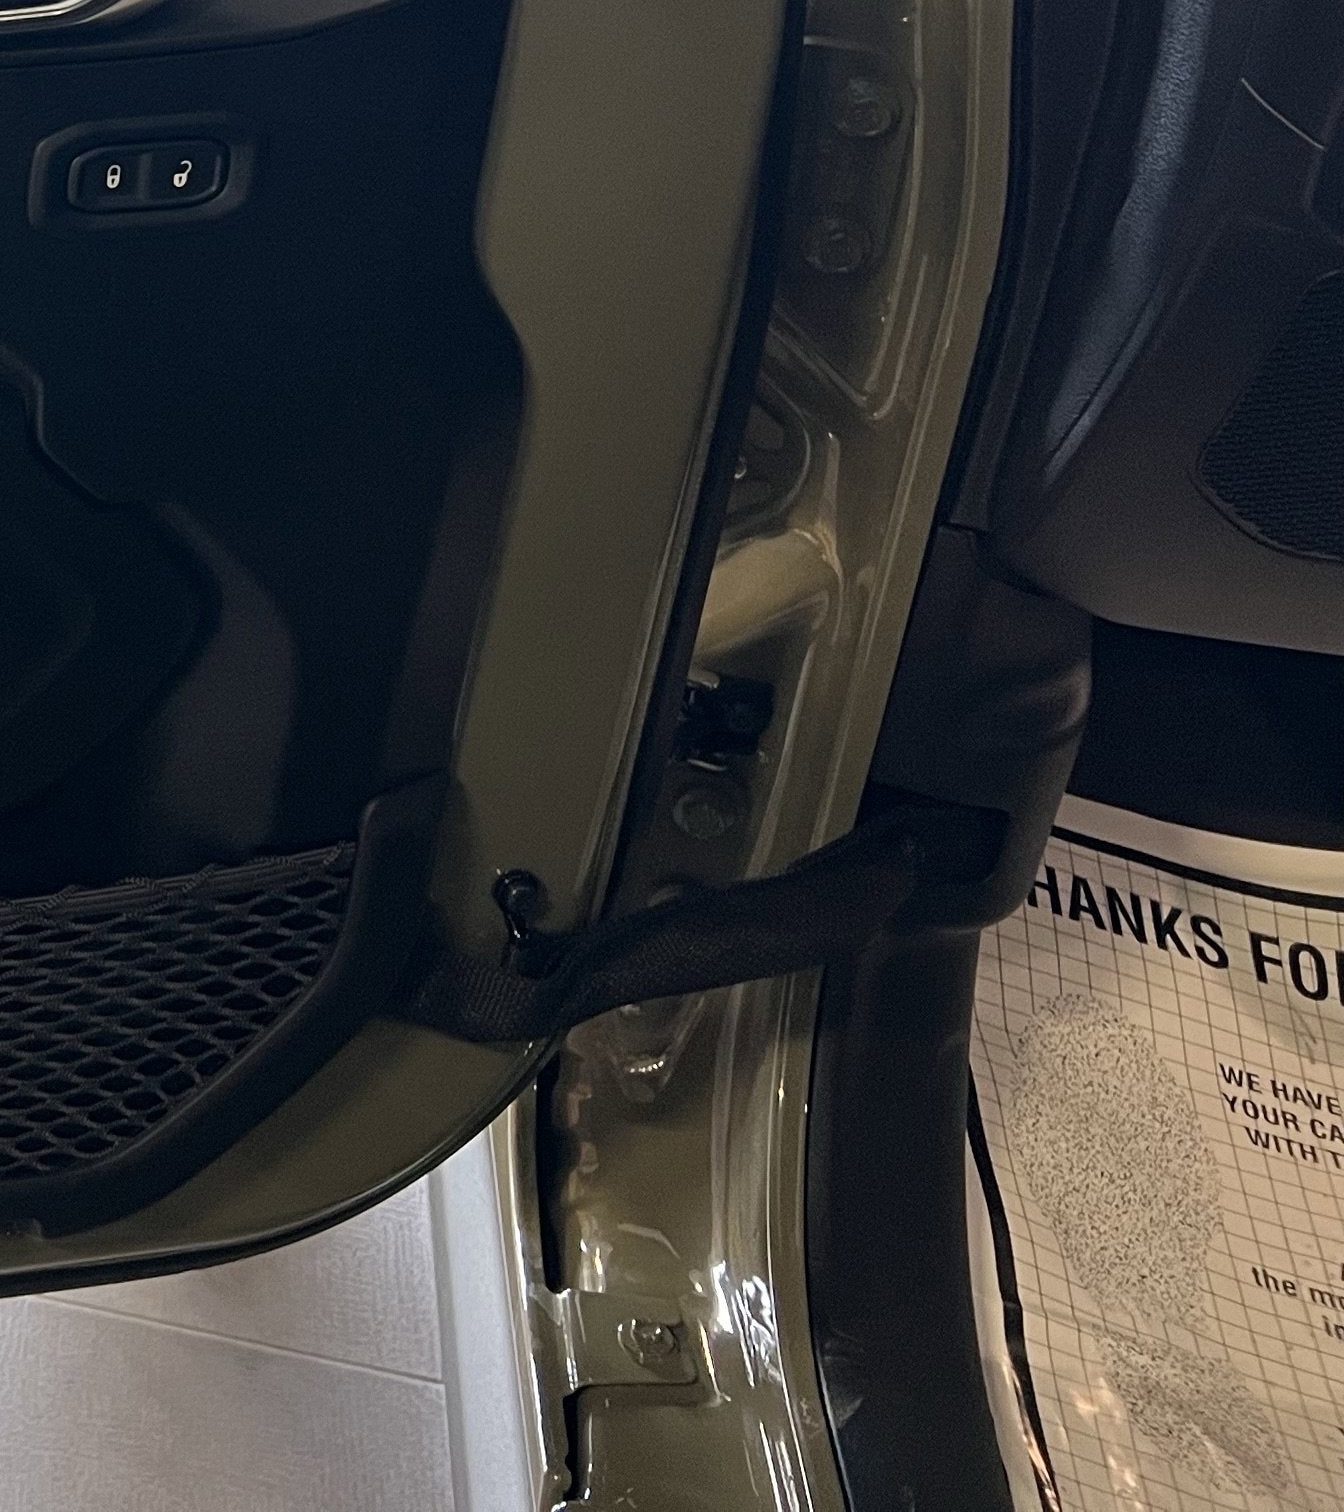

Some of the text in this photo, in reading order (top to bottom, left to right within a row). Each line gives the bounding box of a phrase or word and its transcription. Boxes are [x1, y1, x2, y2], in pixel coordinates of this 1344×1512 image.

[1027, 864, 1230, 969] HANKS
[1219, 1062, 1344, 1117] WE HAVE
[1222, 1092, 1344, 1145] YOUR CA
[1244, 1125, 1319, 1164] WITH
[1252, 1267, 1297, 1297] the
